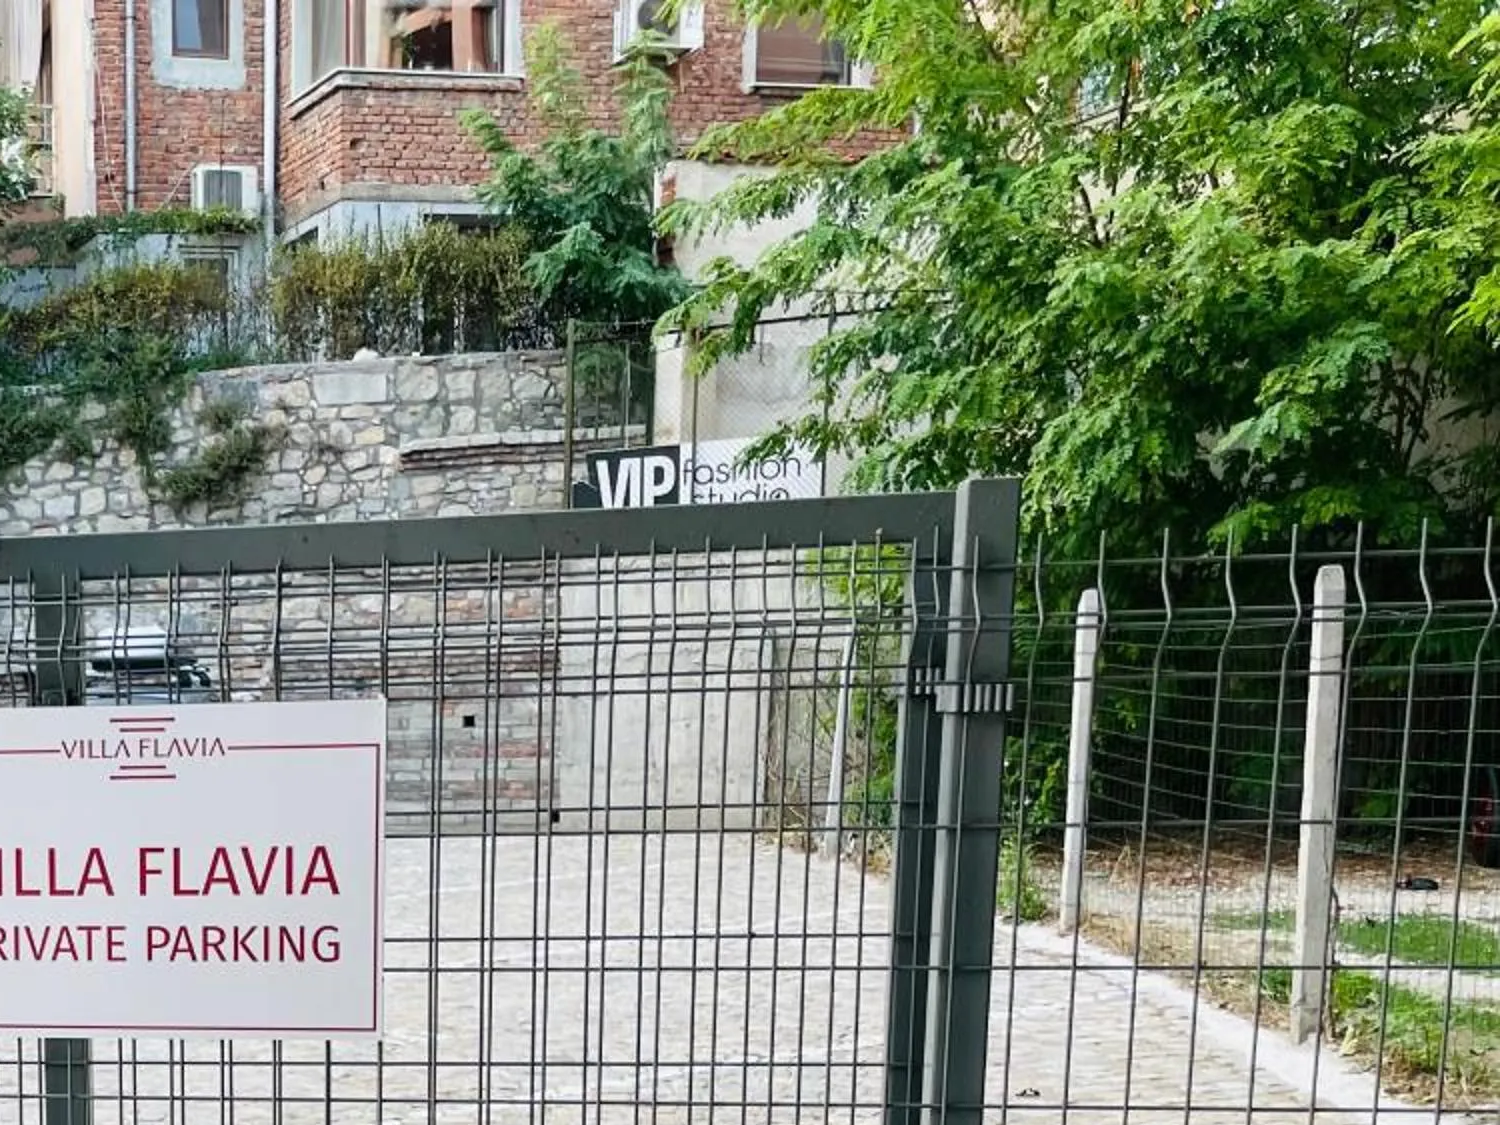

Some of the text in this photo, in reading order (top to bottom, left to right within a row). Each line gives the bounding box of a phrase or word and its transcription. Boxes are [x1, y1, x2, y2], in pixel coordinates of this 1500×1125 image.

[596, 455, 675, 508] VIP
[684, 455, 801, 485] fashion
[61, 736, 226, 759] VILLA FLAVIA
[138, 845, 340, 897] FLAVIA
[147, 925, 341, 963] PARKING
